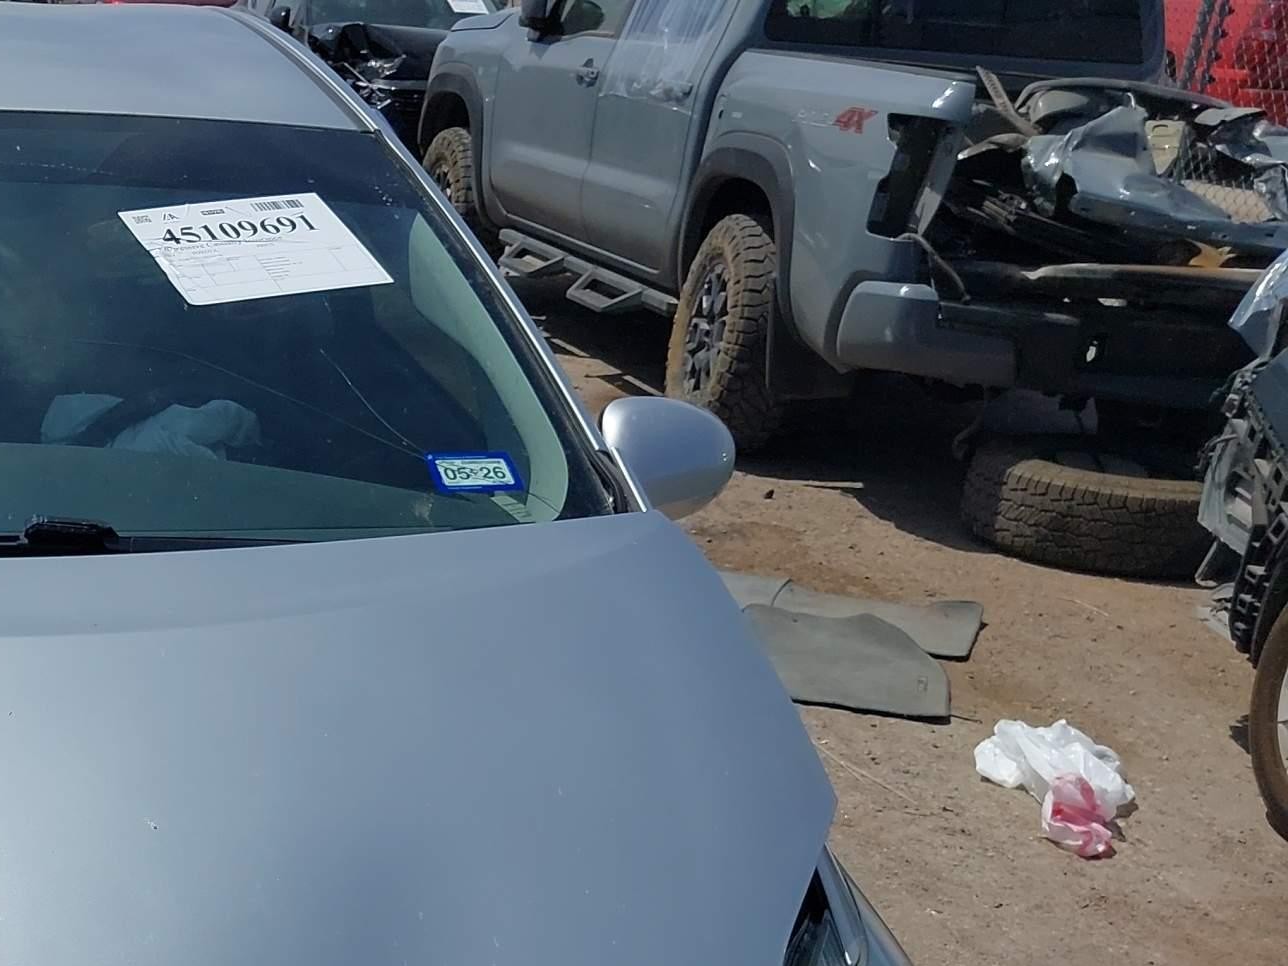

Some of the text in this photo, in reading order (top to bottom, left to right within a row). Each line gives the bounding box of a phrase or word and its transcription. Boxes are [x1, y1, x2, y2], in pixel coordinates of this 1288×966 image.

[162, 213, 320, 245] 45109691
[444, 466, 506, 481] 05 26
